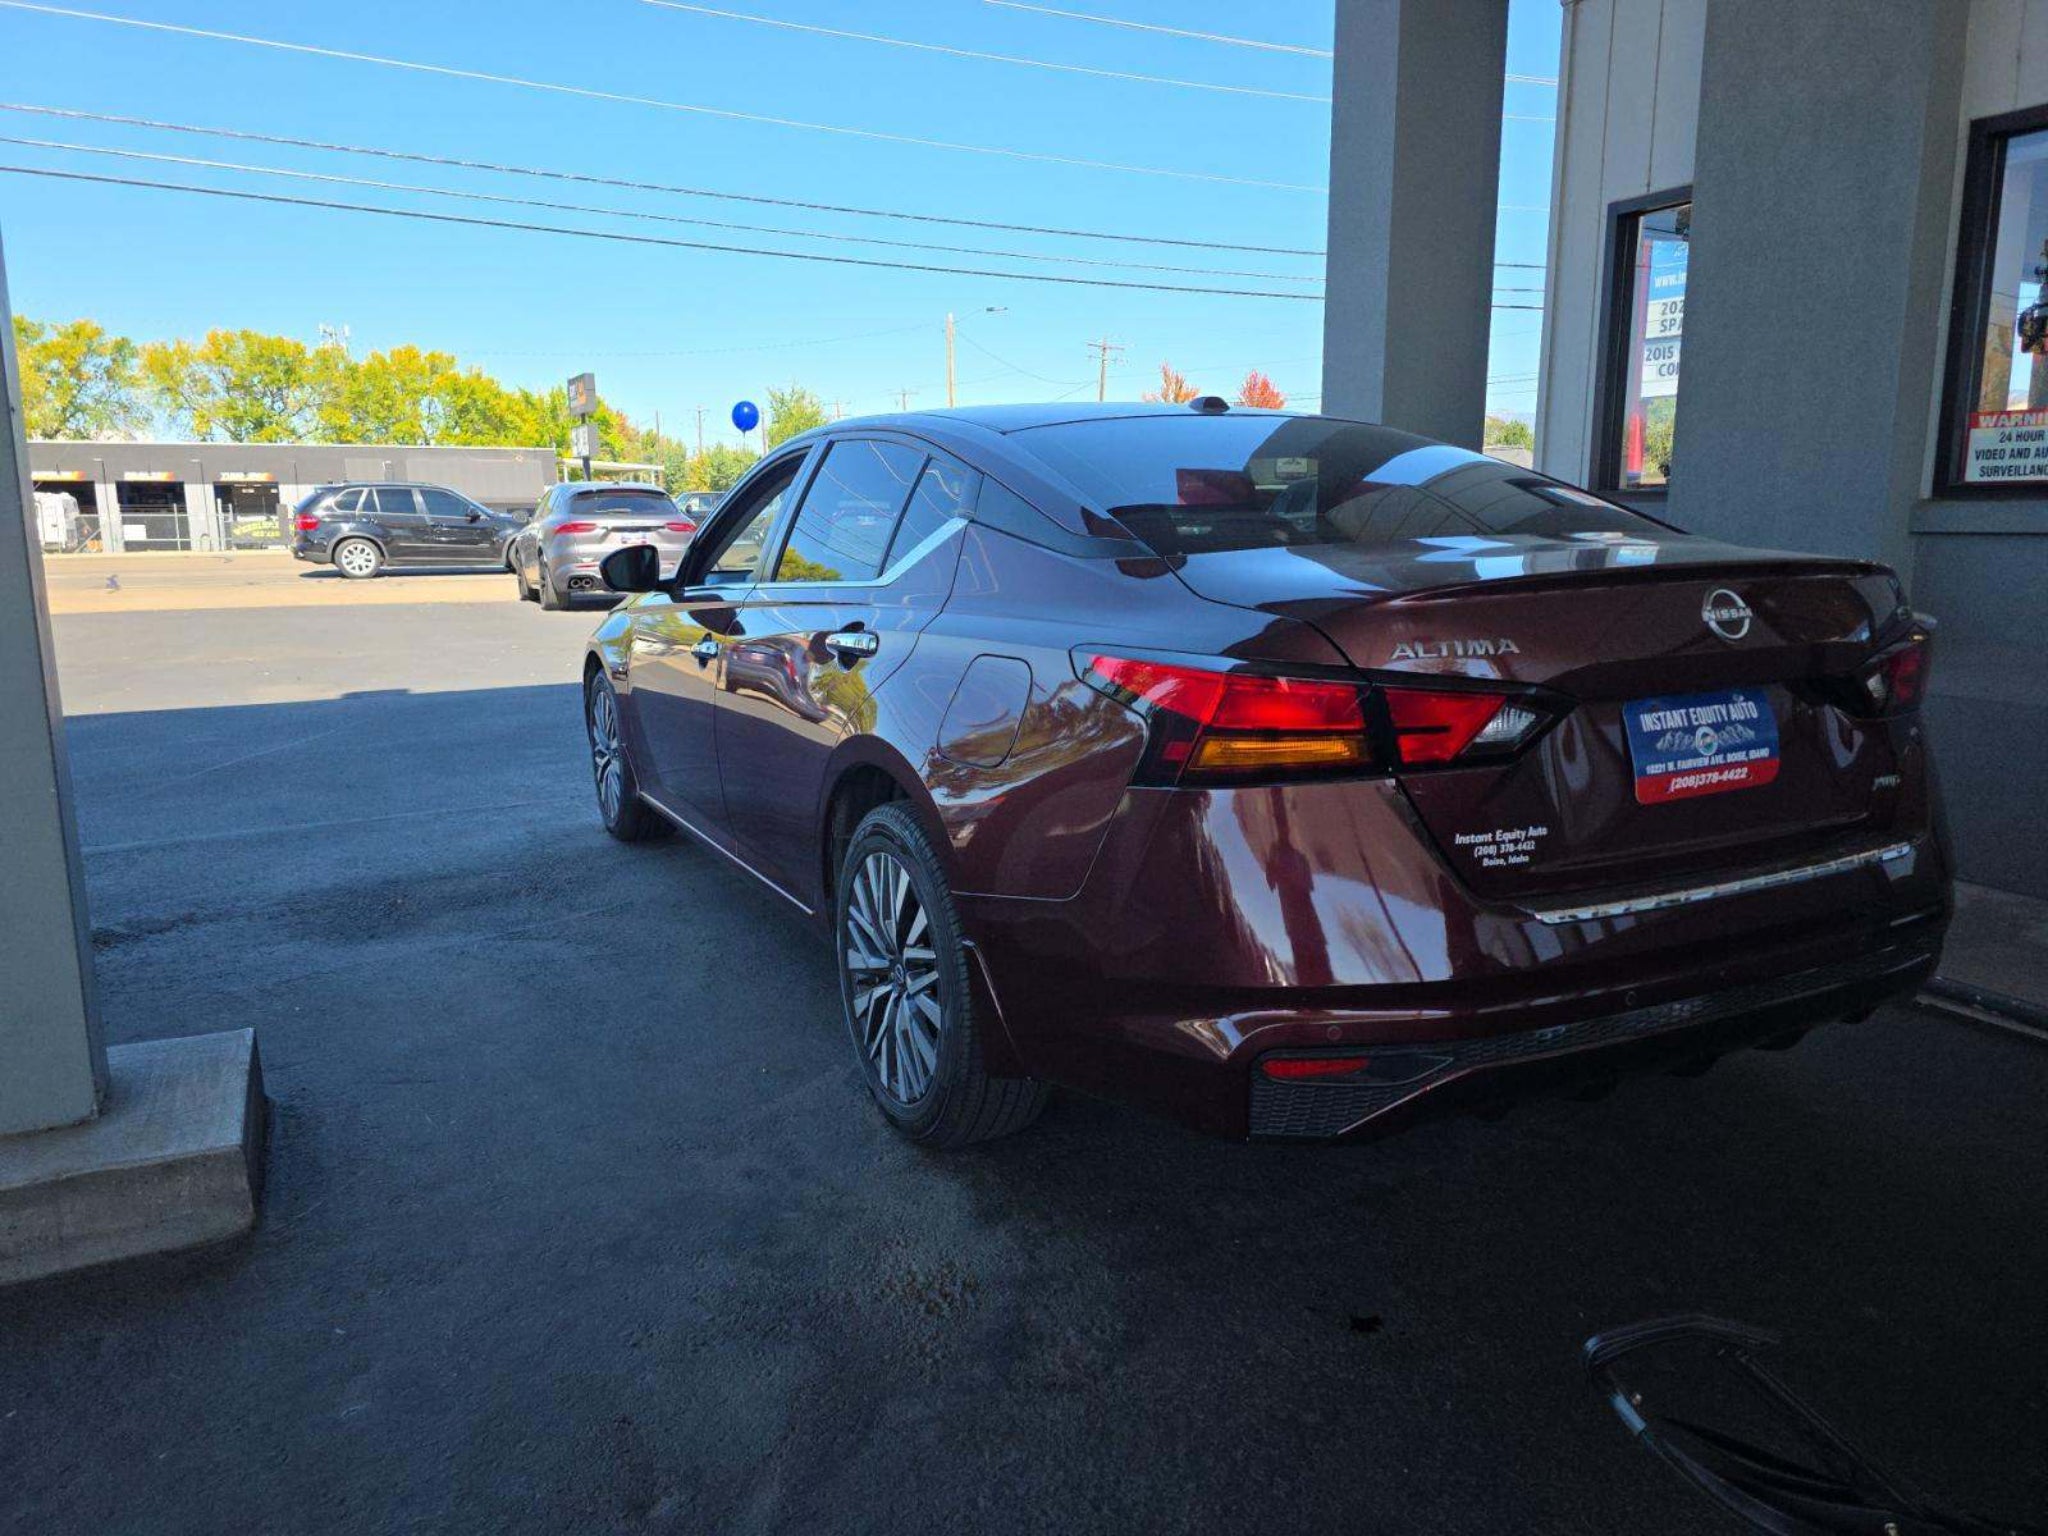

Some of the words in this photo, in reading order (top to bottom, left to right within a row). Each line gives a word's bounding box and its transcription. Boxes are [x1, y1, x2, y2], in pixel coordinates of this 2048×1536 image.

[1646, 346, 1674, 362] 2015
[1999, 431, 2012, 443] 24
[2015, 429, 2045, 442] HOUR
[1975, 448, 2006, 461] VIDEO
[2008, 447, 2031, 459] AND
[1391, 638, 1520, 660] ALTIMA
[1640, 709, 1688, 731] INSTANT
[1689, 705, 1728, 725] EQUITY
[1728, 701, 1758, 721] AUTO
[1455, 833, 1493, 844] Instant
[1496, 829, 1526, 843] Equity
[1528, 826, 1548, 837] Auto
[1474, 845, 1497, 858] (208)
